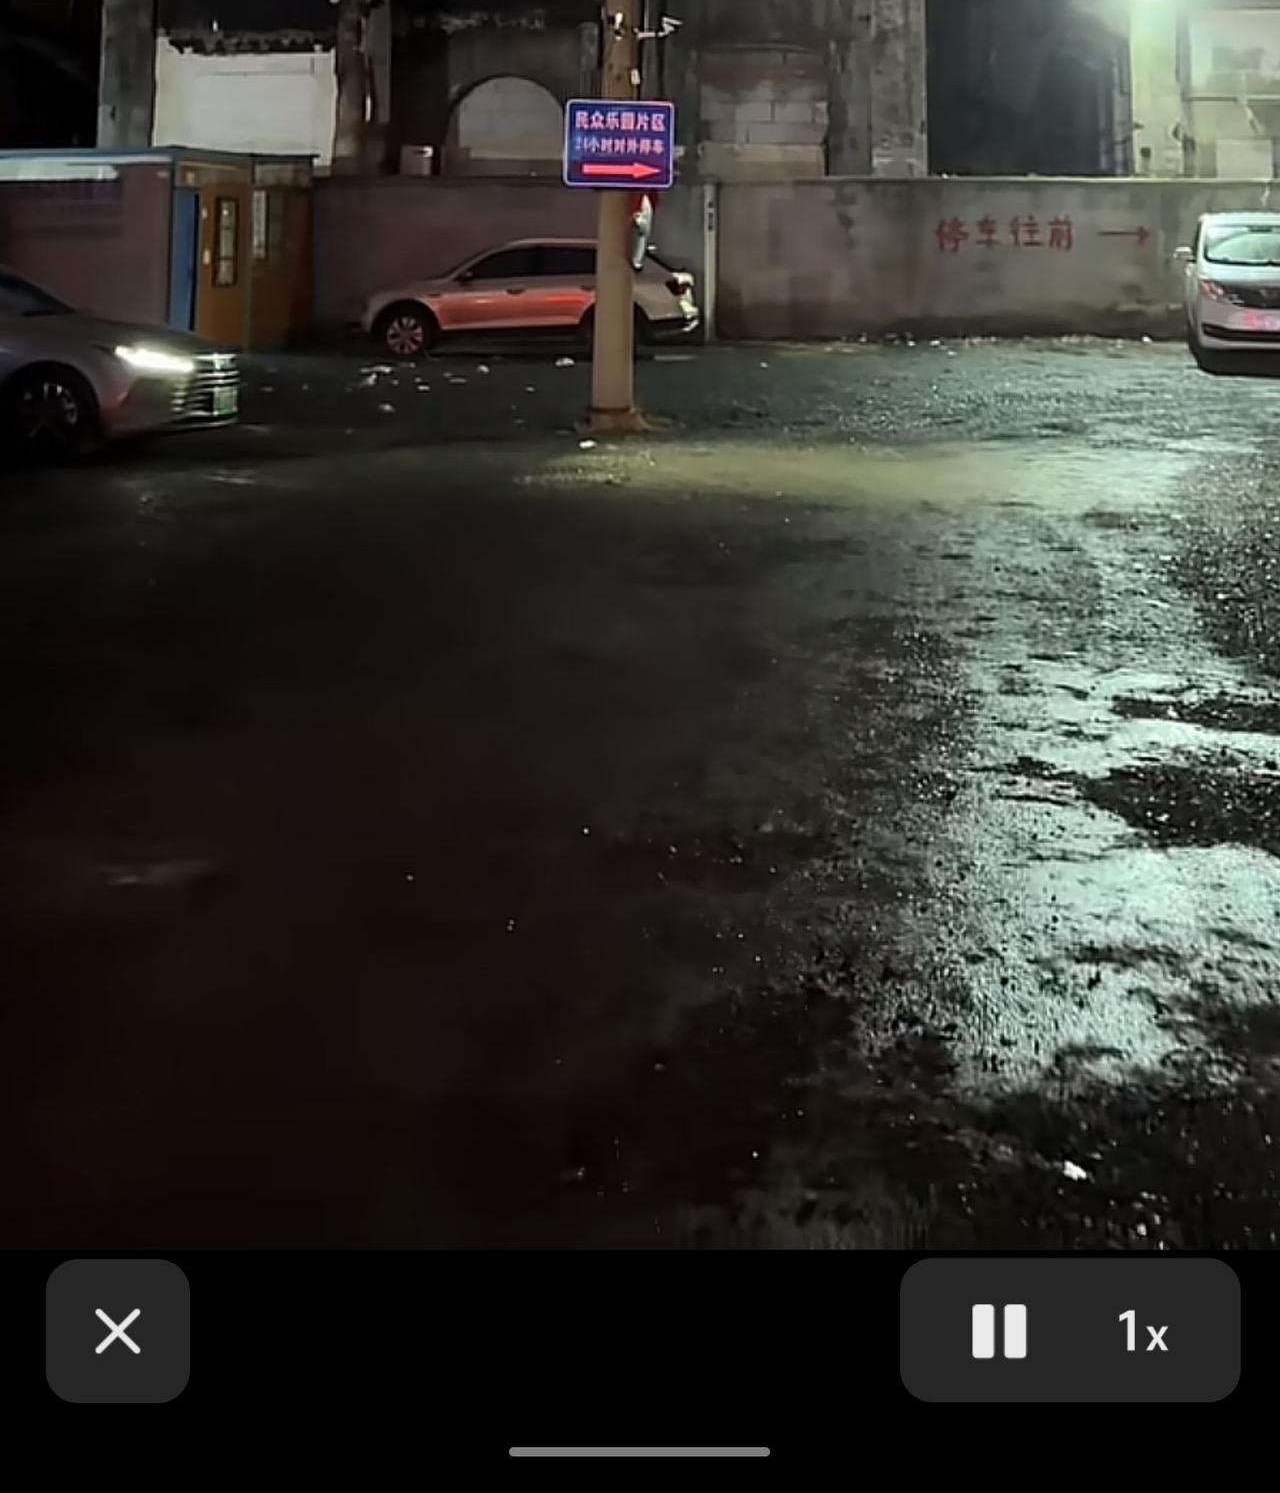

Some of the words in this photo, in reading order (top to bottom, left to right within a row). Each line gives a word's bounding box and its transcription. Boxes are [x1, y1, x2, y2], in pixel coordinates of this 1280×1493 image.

[575, 110, 666, 132] 民众乐园片区
[934, 214, 1074, 253] 停车往前
